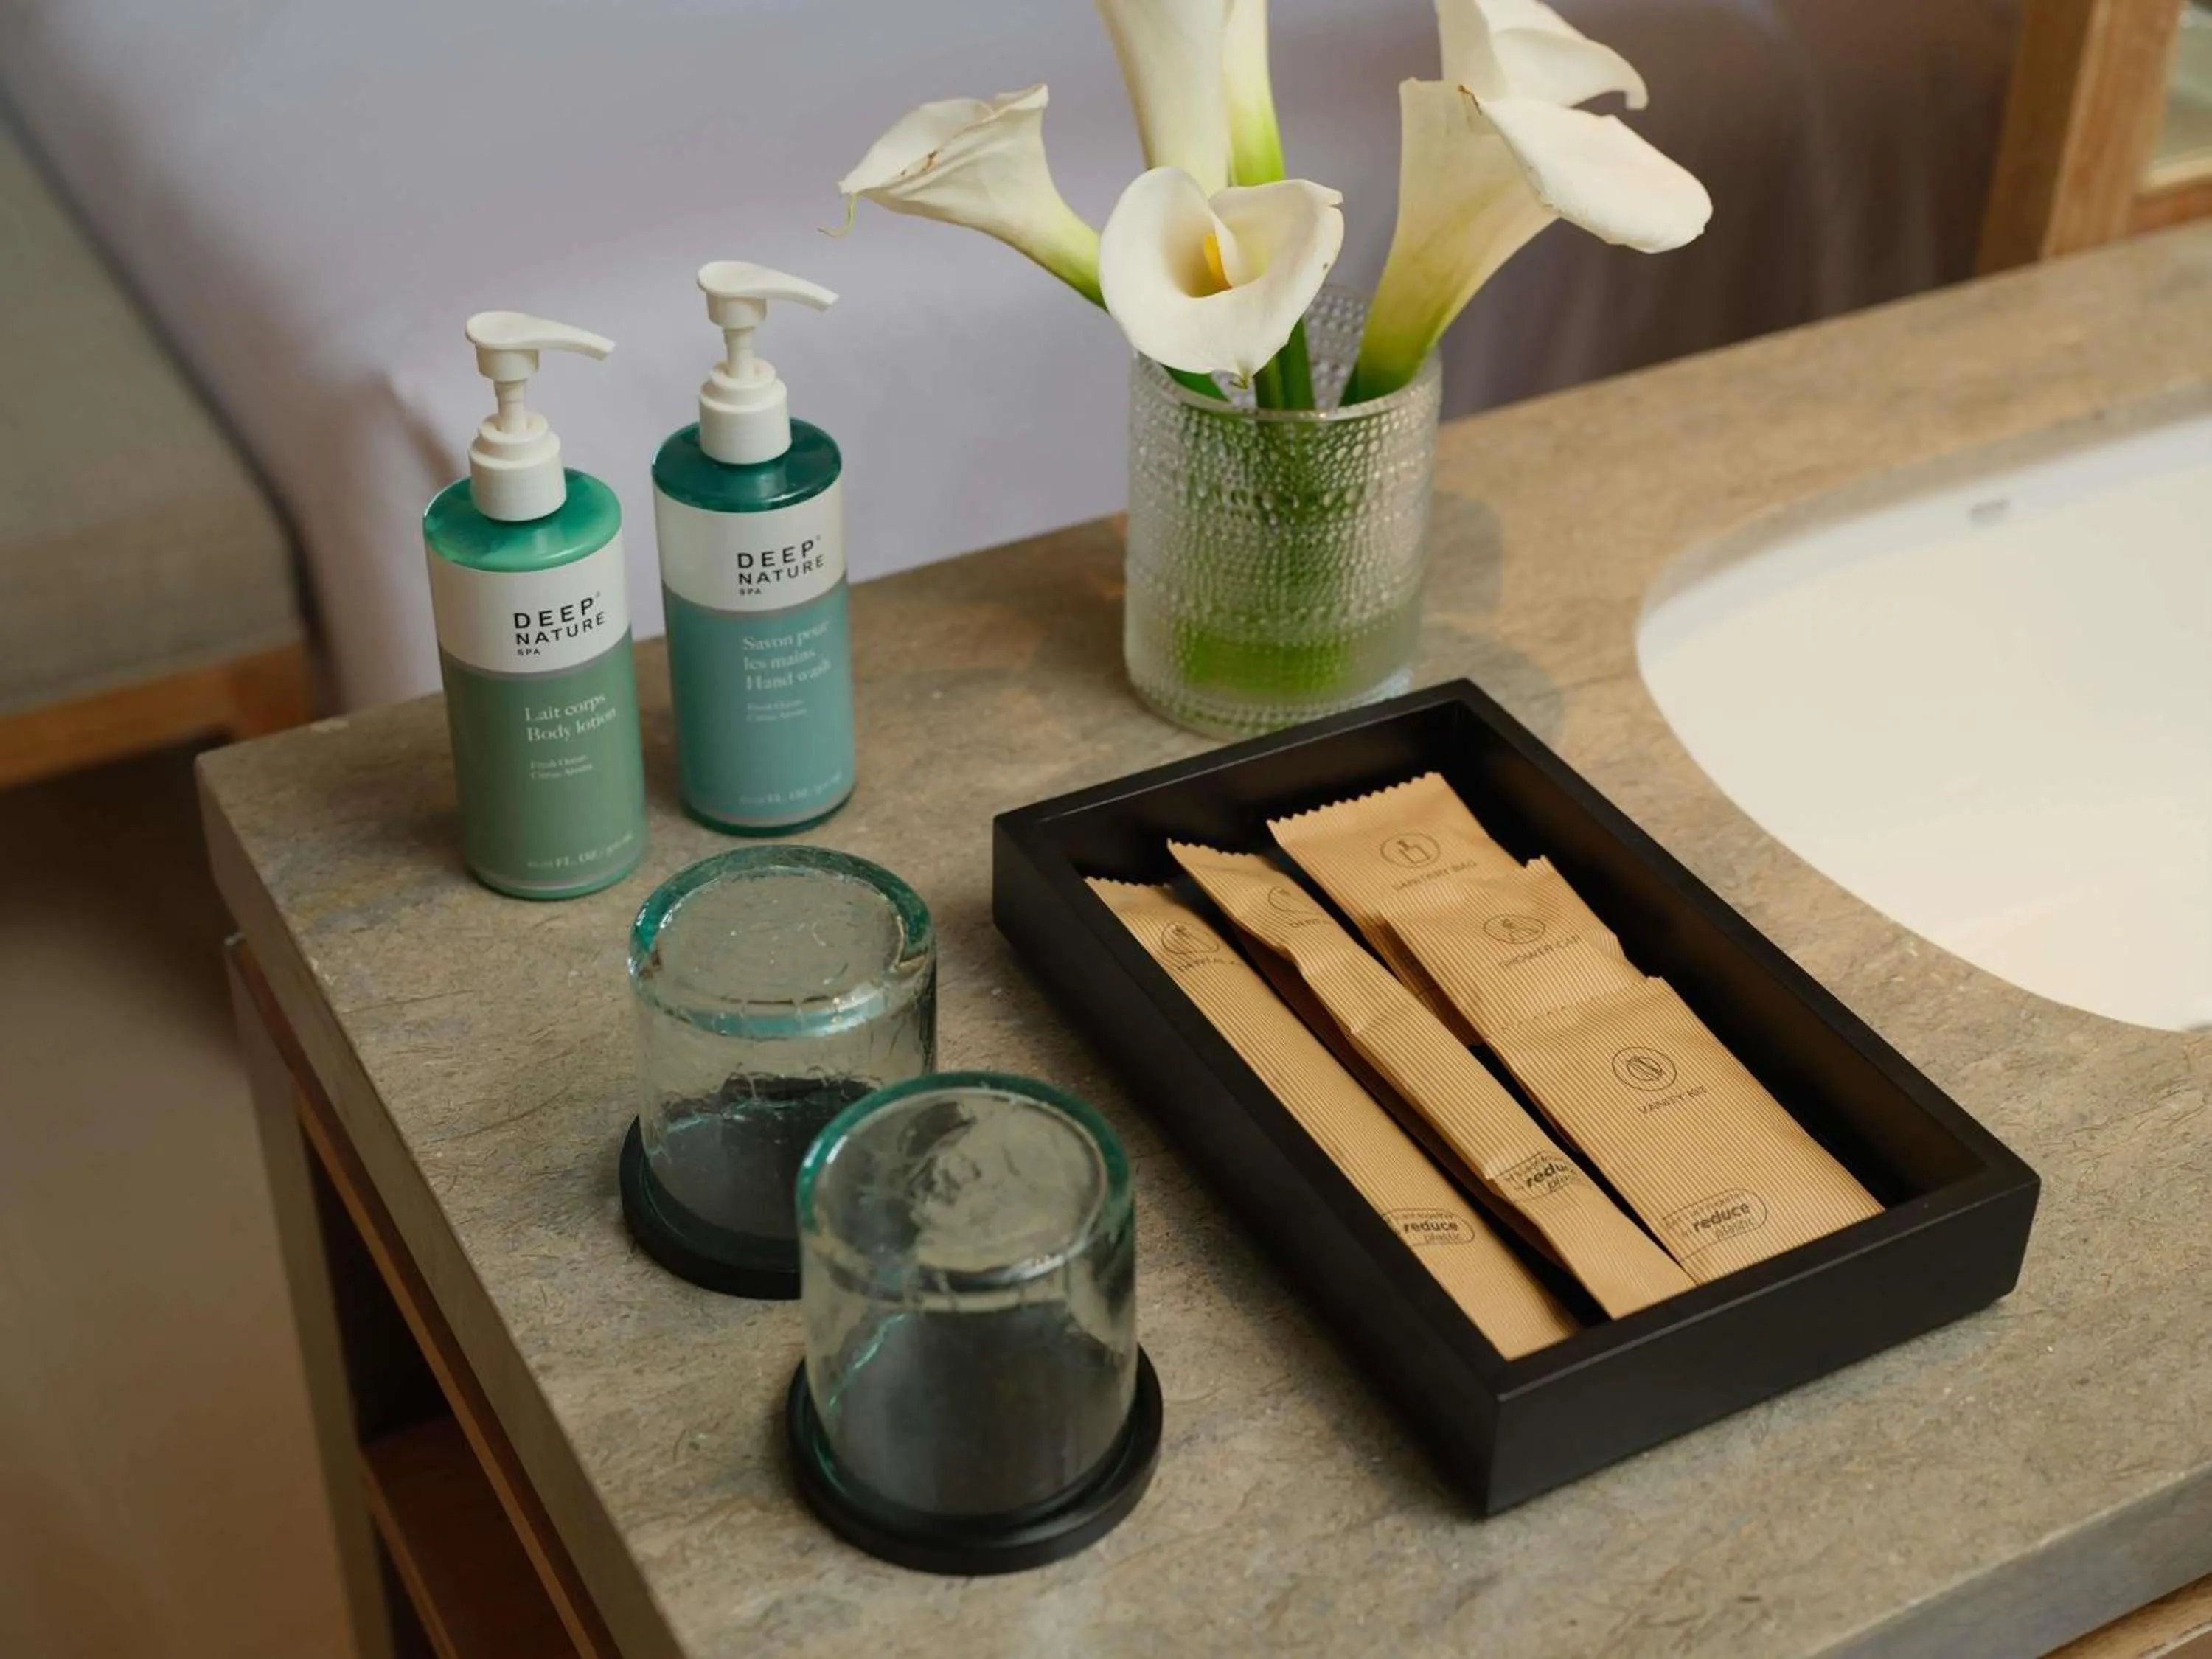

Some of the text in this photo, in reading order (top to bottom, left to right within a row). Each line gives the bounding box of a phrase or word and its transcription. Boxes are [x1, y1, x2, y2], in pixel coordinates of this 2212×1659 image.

[737, 540, 813, 568] DEEP
[739, 554, 824, 585] NATURE
[513, 597, 594, 629] DEEP
[516, 611, 605, 645] NATURE
[517, 648, 540, 656] SPA
[745, 672, 793, 691] Hand
[525, 693, 606, 722] Lait corps
[526, 723, 571, 742] Body
[1404, 1220, 1458, 1233] reduce
[1693, 1203, 1750, 1233] reduce
